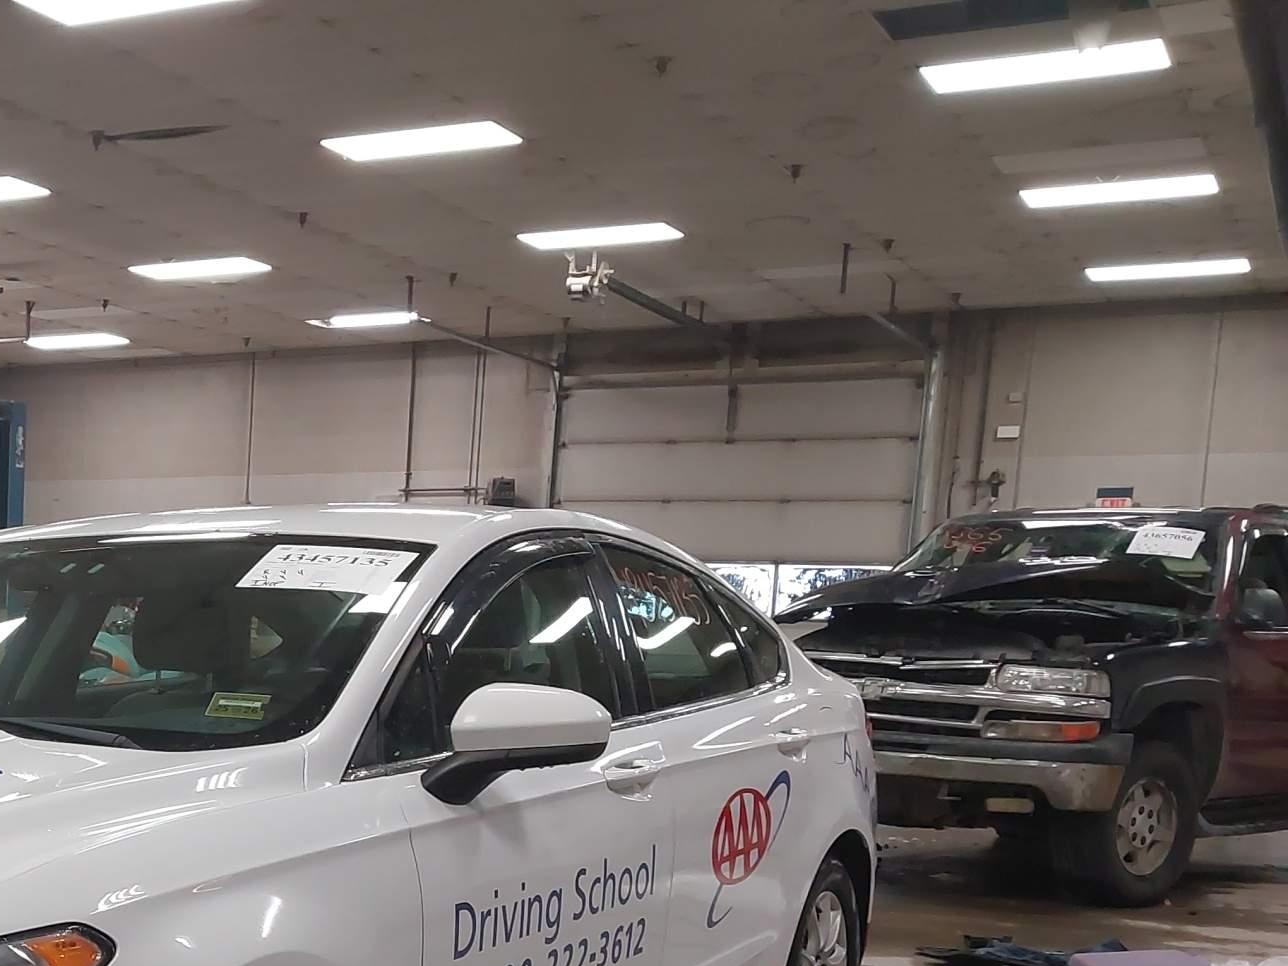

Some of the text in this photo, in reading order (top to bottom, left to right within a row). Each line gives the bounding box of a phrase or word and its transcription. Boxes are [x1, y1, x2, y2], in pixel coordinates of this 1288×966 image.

[276, 553, 392, 567] 43457135
[713, 789, 771, 884] AAA
[453, 844, 656, 960] Driving School
